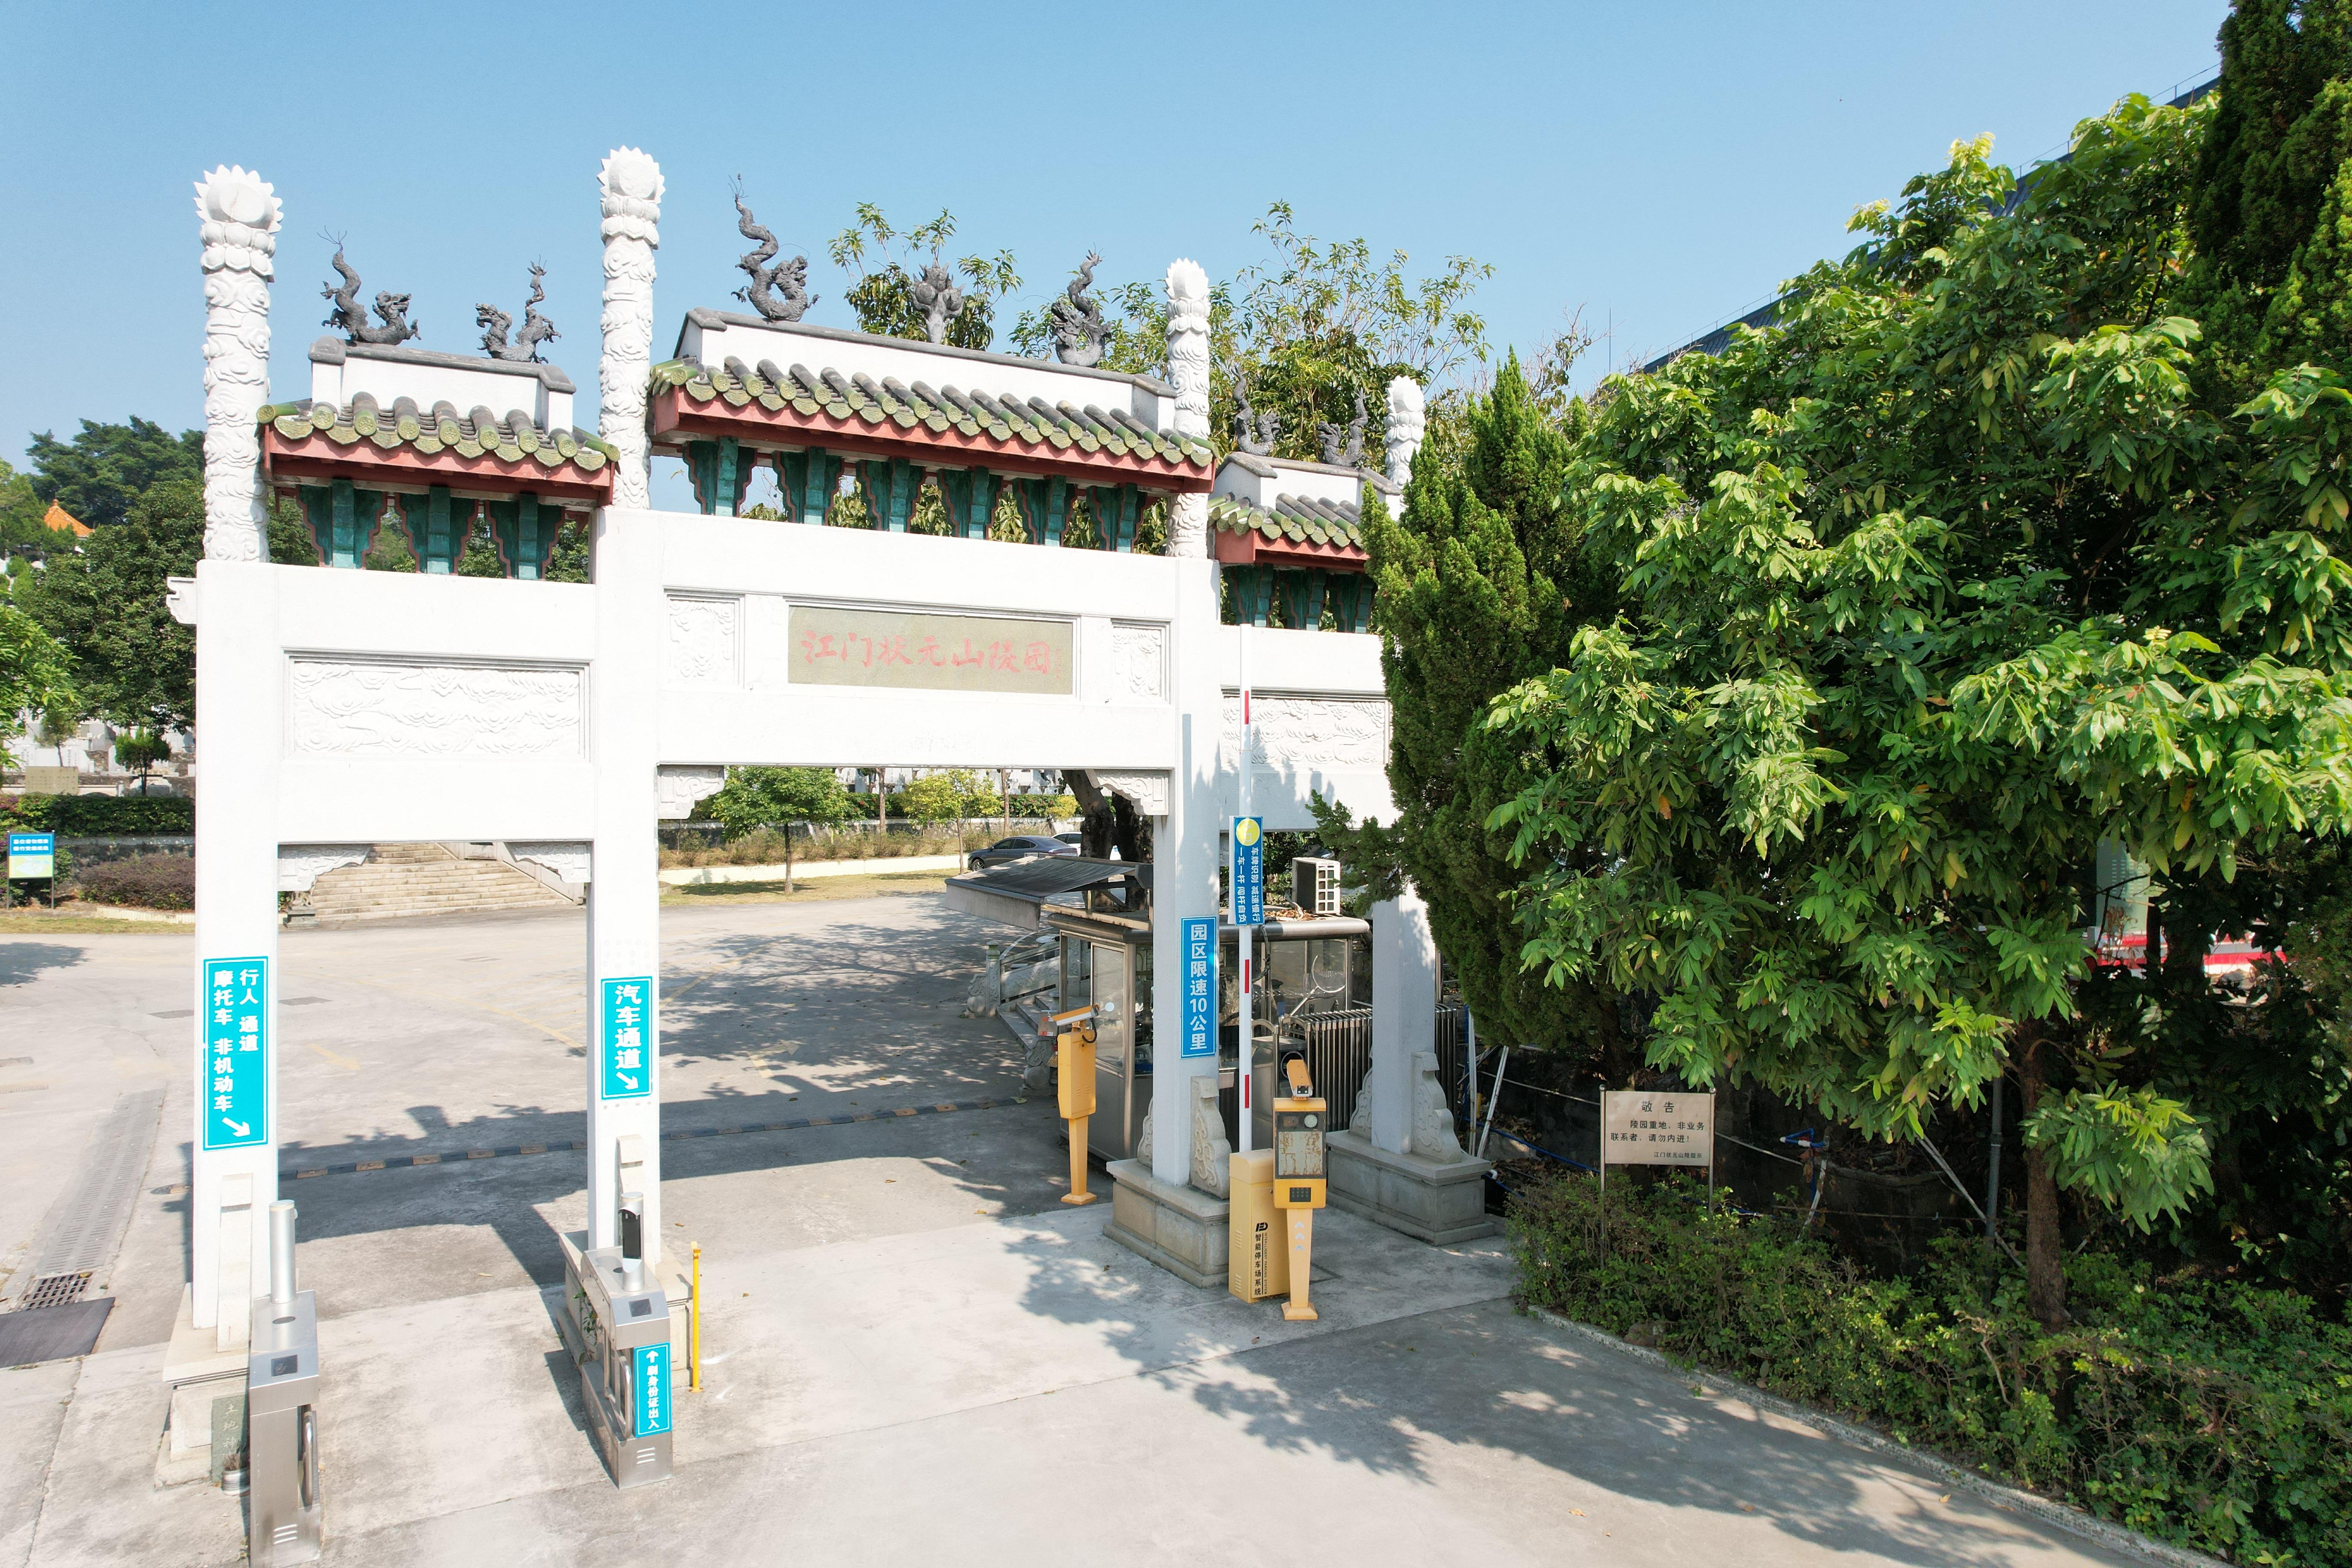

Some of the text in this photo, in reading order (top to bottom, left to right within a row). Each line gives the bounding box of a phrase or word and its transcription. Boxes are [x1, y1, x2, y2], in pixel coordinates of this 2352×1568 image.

[800, 630, 1050, 674] 江门状元山陵园
[1237, 887, 1246, 922] 闯杆自负
[1251, 886, 1260, 922] 减速慢行
[239, 969, 259, 1052] 行人 通道
[1190, 924, 1207, 1050] 园区限速10公里
[213, 970, 234, 1112] 摩托车 非机动车
[614, 984, 642, 1069] 汽车通道
[1642, 1101, 1674, 1113] 敬告
[646, 1365, 659, 1430] 刷身份证出入
